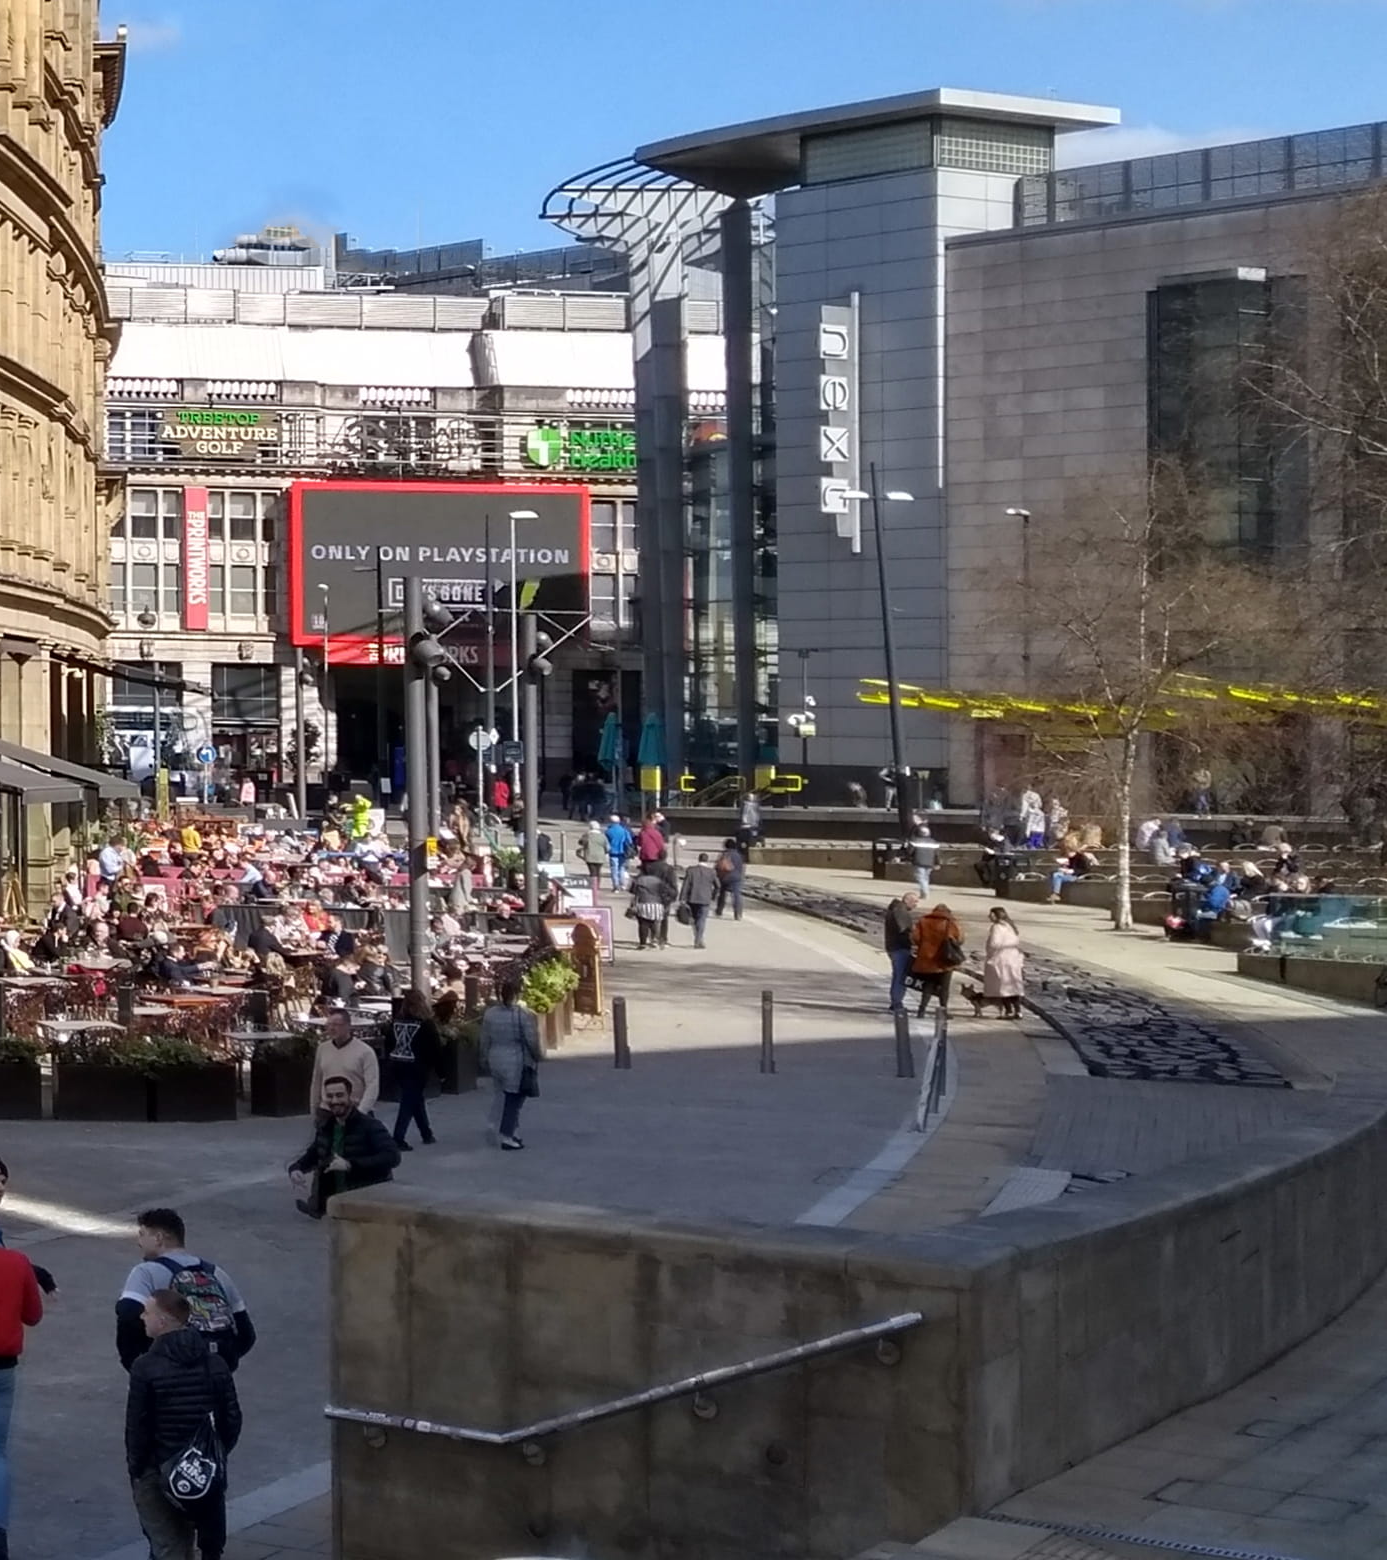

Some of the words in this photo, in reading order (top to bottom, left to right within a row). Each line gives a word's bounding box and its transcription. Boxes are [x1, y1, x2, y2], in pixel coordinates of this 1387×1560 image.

[178, 411, 260, 425] TREETOP
[820, 324, 849, 512] next
[161, 426, 278, 441] ADVENTURE
[570, 431, 636, 448] Nuffie
[196, 442, 244, 454] GOLF
[570, 451, 637, 468] Health
[187, 520, 207, 605] PRINTWORKS
[311, 544, 371, 560] ONLY
[379, 546, 410, 561] ON
[418, 546, 570, 564] PLAYSTATION
[440, 585, 484, 601] GONE
